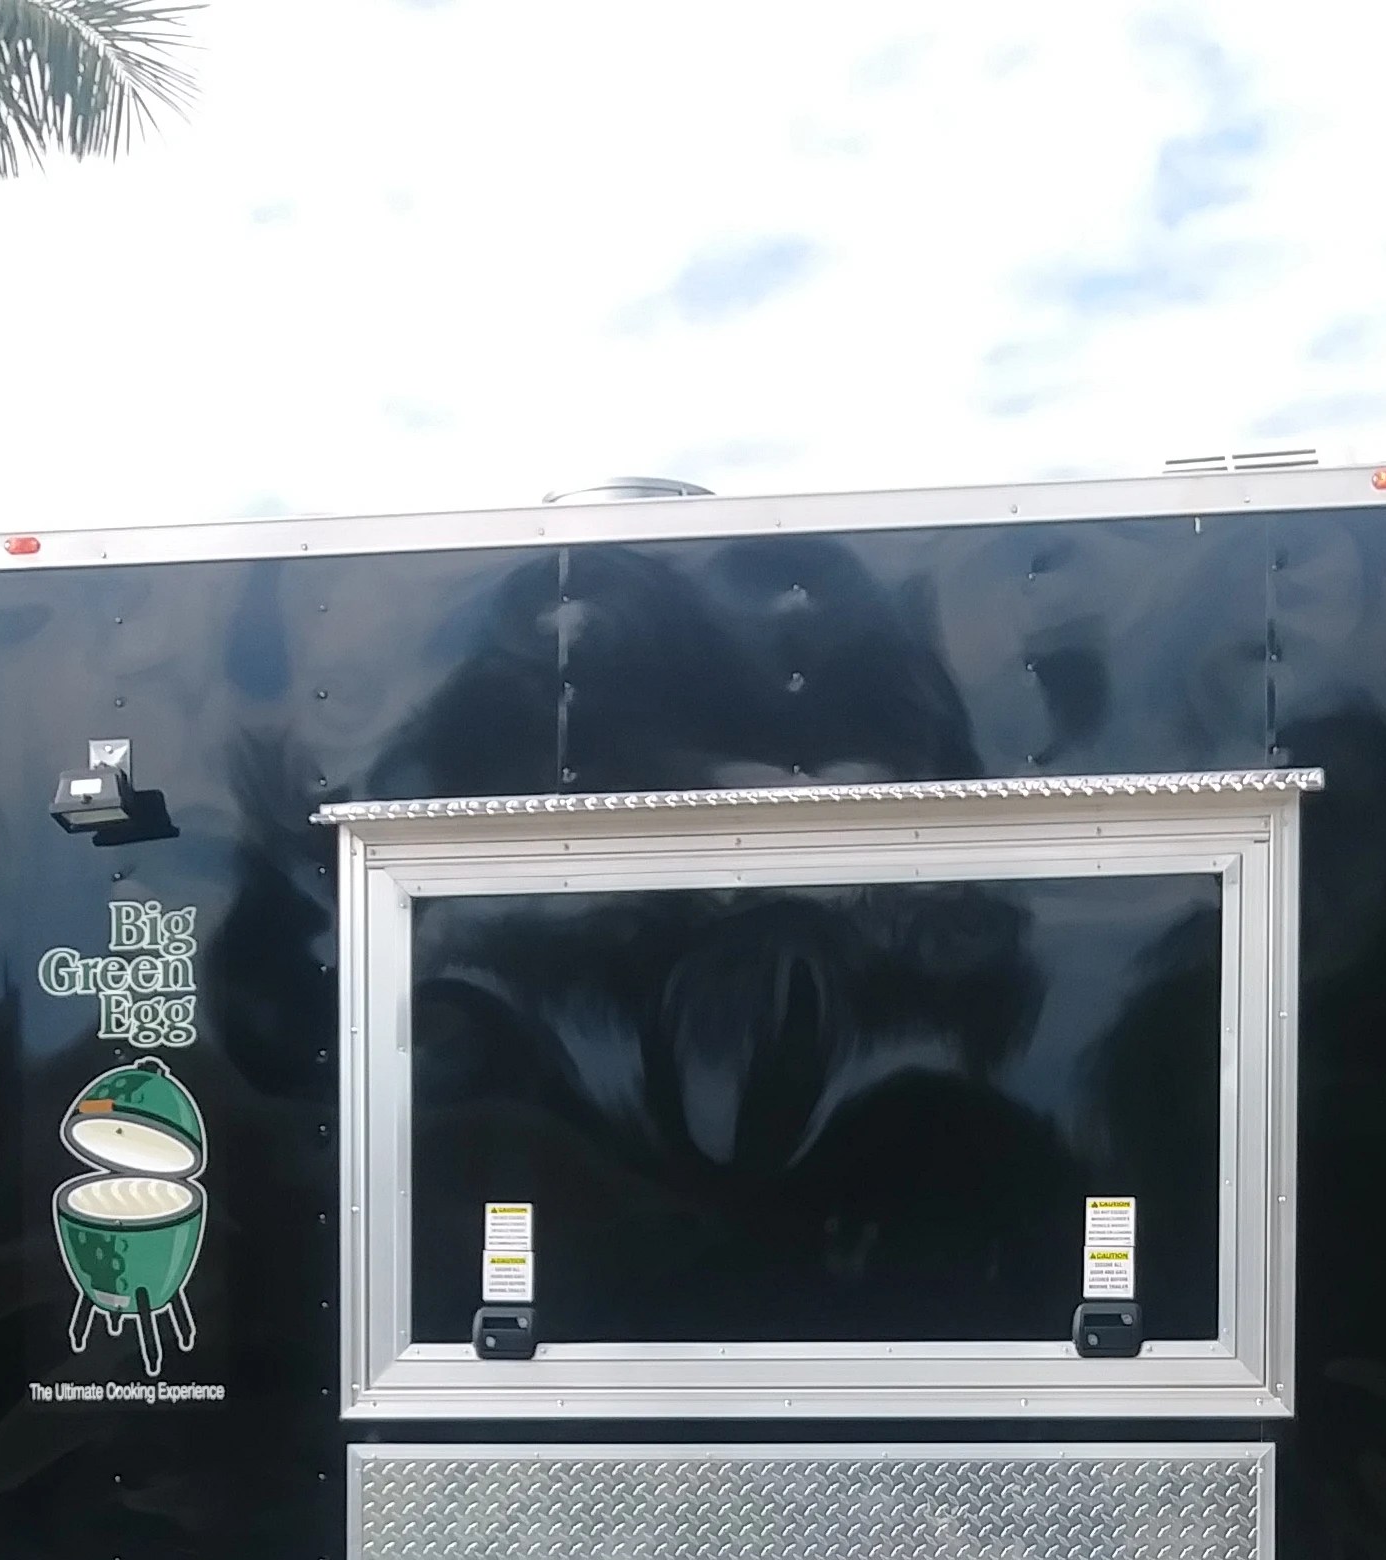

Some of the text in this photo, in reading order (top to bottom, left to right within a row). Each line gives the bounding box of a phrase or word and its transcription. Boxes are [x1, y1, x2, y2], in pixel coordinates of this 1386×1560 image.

[109, 901, 197, 957] Big
[38, 947, 197, 996] Green
[98, 990, 197, 1047] Egg
[1096, 1252, 1129, 1260] CAUTION
[29, 1382, 225, 1404] The Ultimate Cooking Experience
